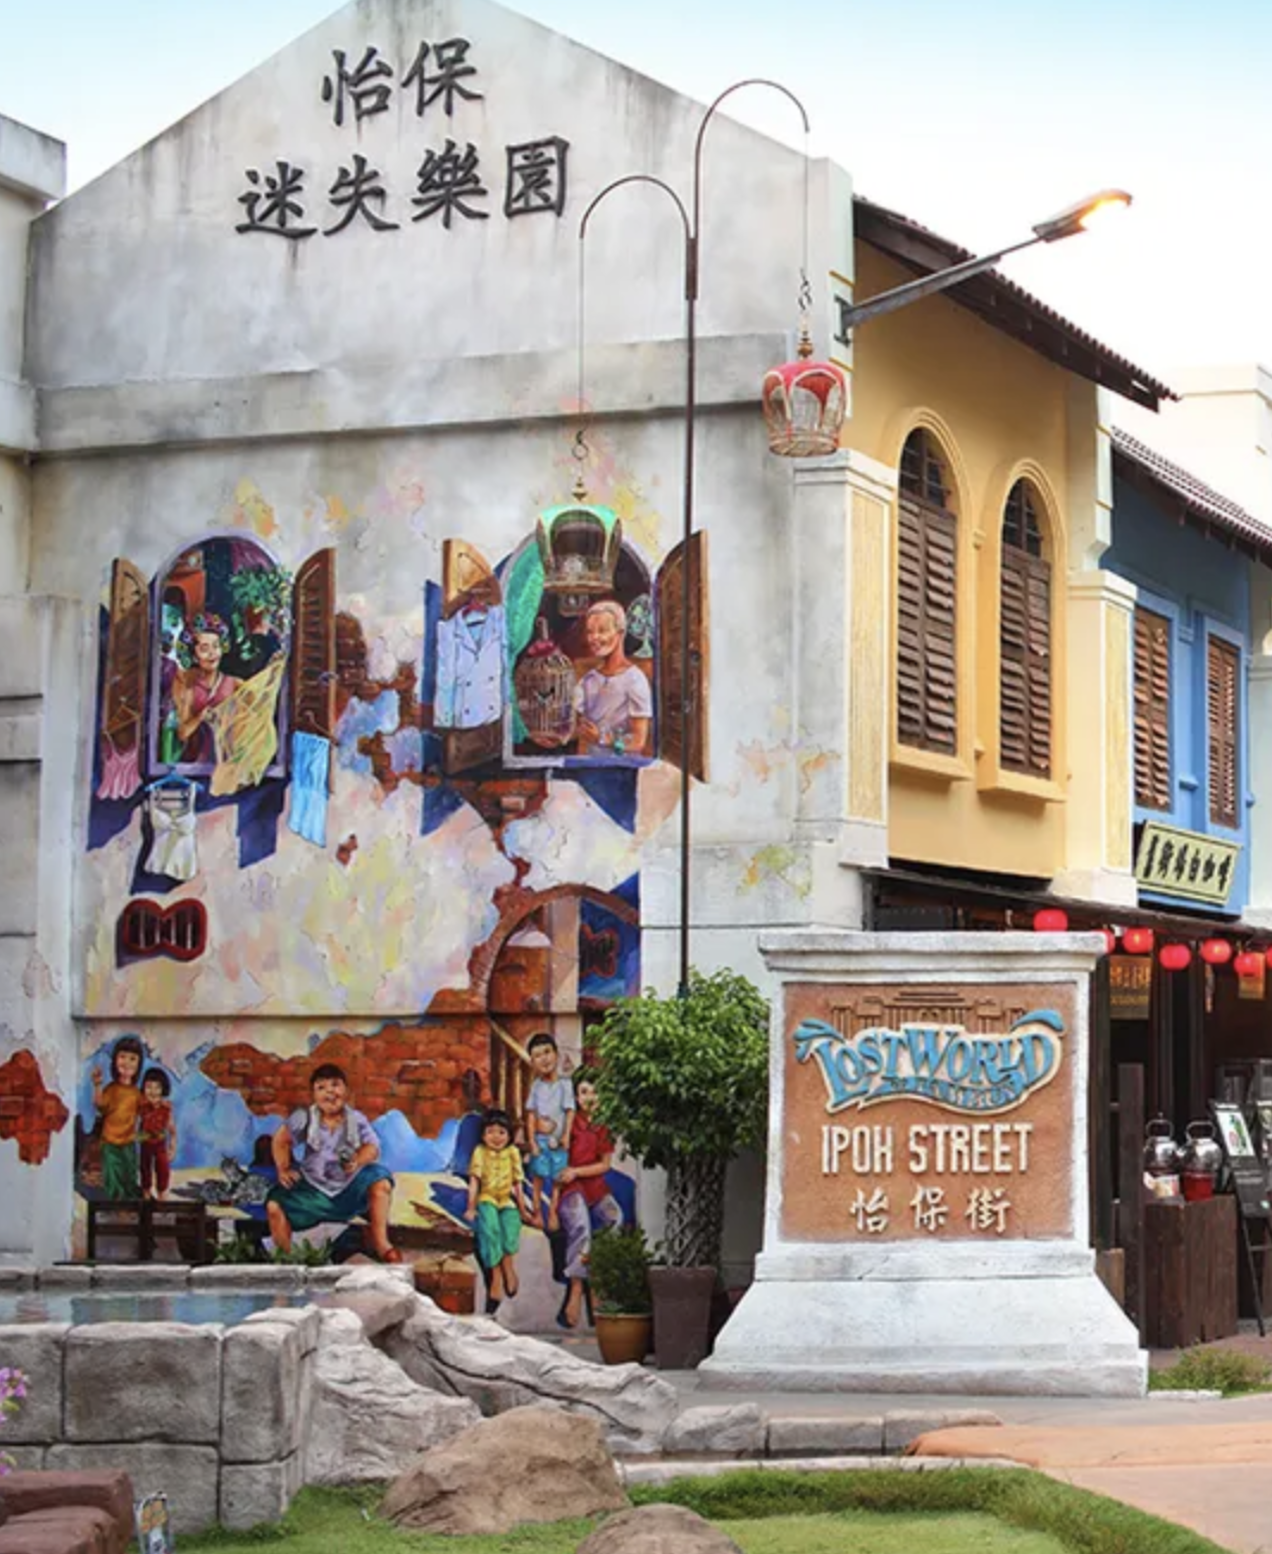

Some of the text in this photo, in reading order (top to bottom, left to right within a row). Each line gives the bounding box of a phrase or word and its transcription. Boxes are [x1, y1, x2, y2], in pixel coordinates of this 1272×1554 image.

[322, 38, 484, 127] 怡保
[234, 135, 571, 240] 迷失樂園
[903, 1028, 1055, 1089] WORLD
[821, 1122, 1034, 1174] IPOH STREET
[849, 1183, 1012, 1233] 怡保街
